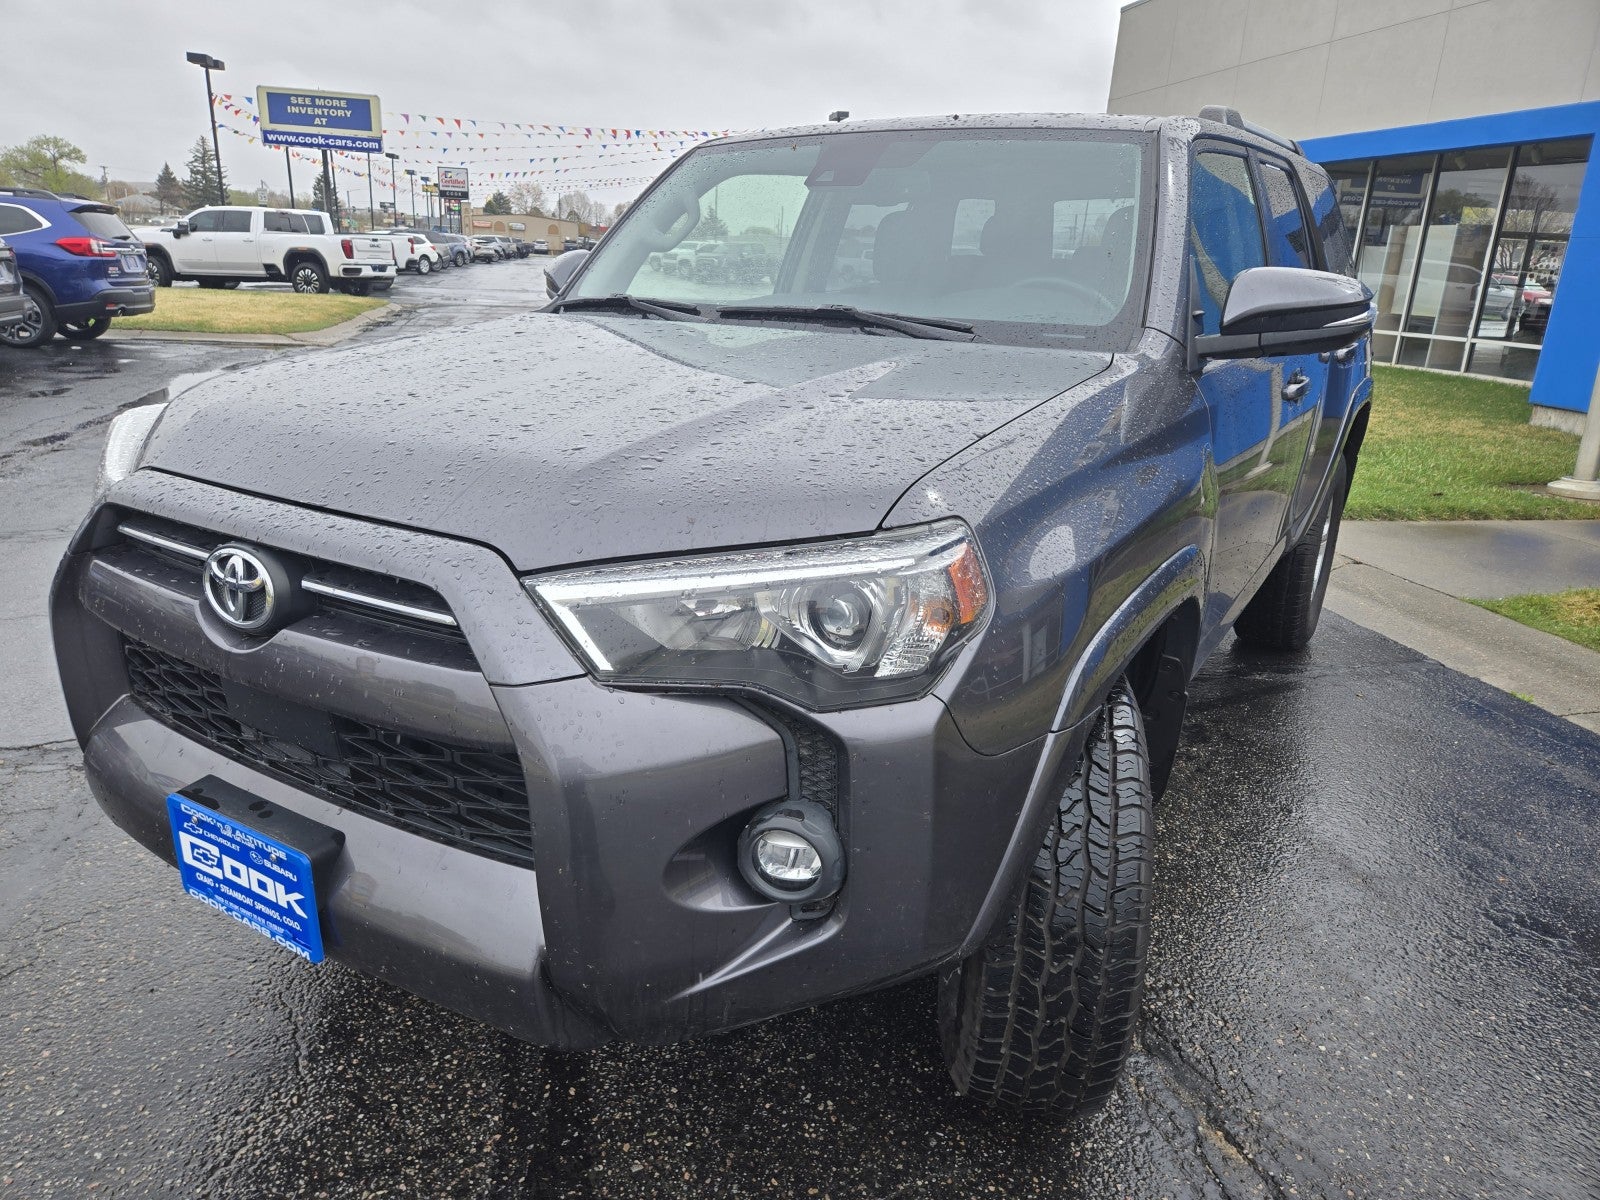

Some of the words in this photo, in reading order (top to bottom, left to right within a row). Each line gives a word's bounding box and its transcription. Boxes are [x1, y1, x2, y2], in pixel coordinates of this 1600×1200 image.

[287, 105, 352, 118] INVENTORY
[290, 96, 312, 105] SEE
[315, 98, 348, 108] MORE
[313, 117, 328, 126] AT
[266, 132, 379, 149] www.cook-cars.com
[203, 830, 240, 852] CHEVROLET
[235, 830, 287, 860] ALTITUDE
[263, 859, 297, 882] SUBARU
[196, 872, 214, 888] CRAIG
[220, 883, 254, 907] STEAMBOAT
[189, 888, 311, 961] COOK-CARS.COM
